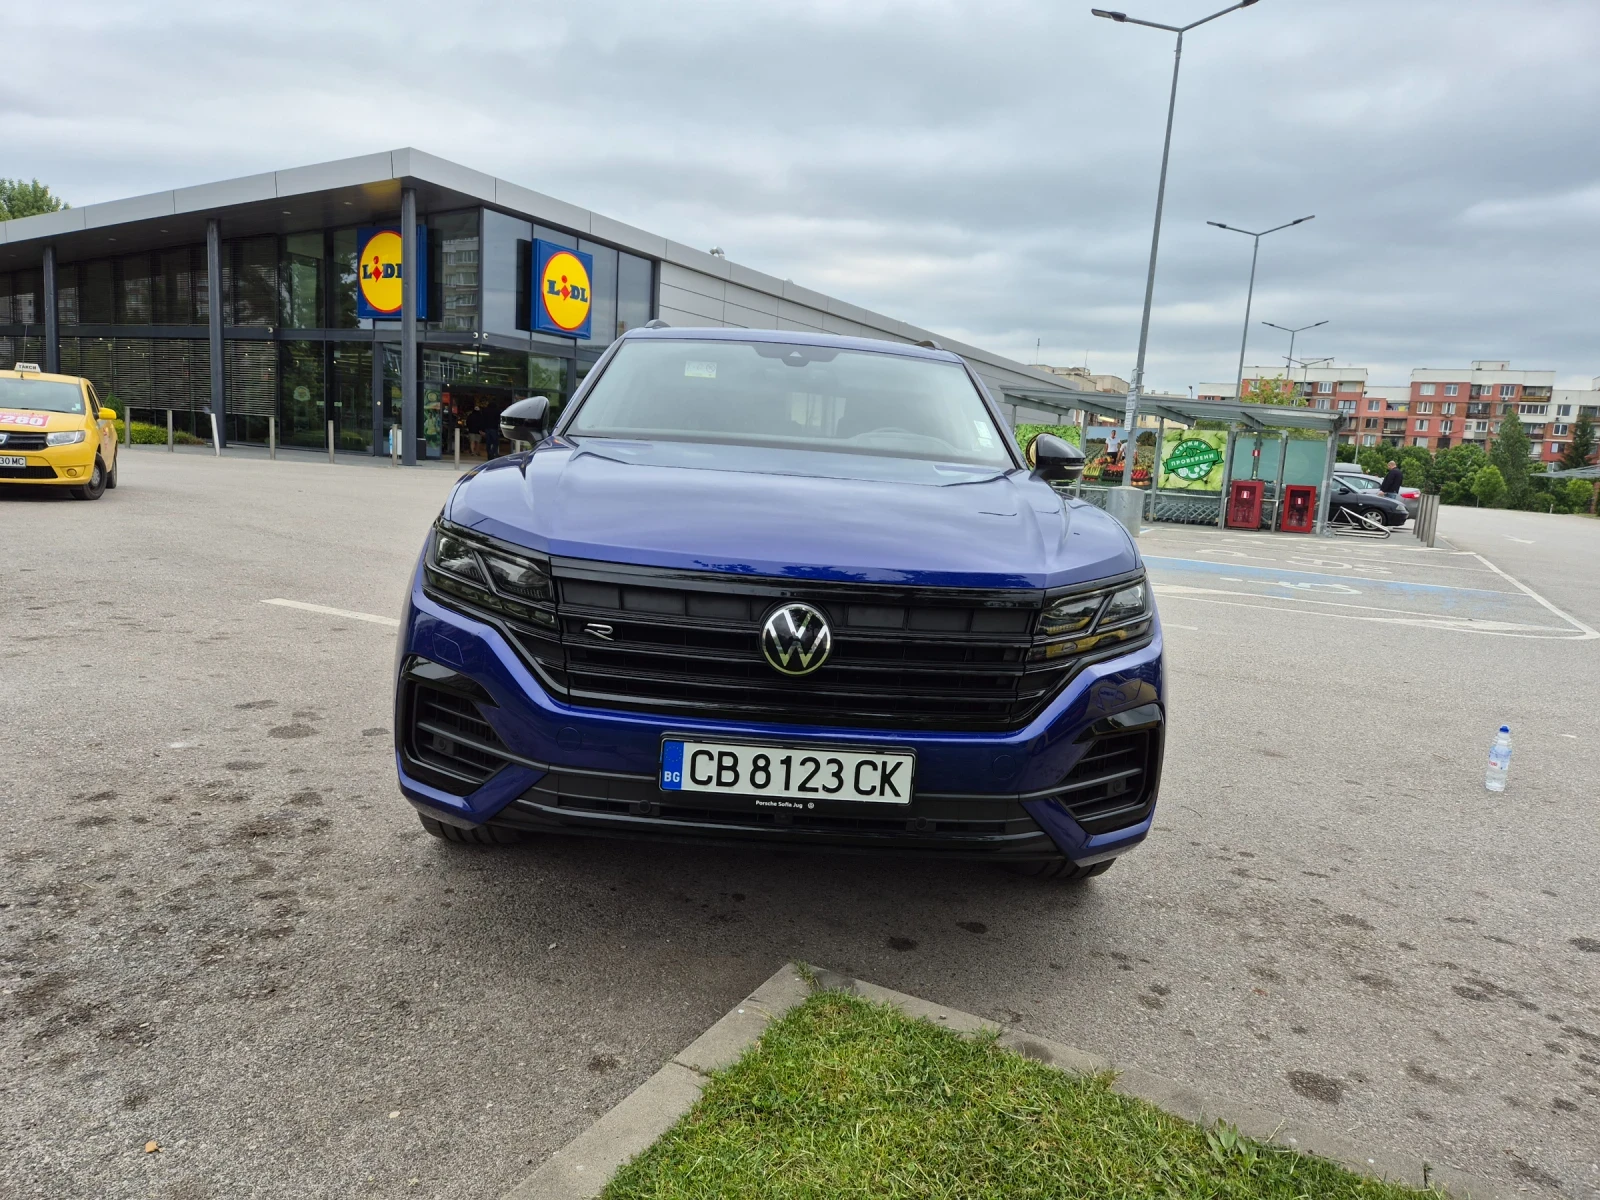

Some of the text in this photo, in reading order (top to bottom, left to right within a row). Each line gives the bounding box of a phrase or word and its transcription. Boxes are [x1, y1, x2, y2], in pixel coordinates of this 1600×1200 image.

[547, 275, 588, 303] LIDL
[1175, 441, 1199, 454] СВЕЖИ
[12, 457, 24, 466] MC
[1171, 453, 1214, 467] ПРОВЕРЕНИ
[664, 771, 680, 783] BG
[690, 749, 904, 797] CB 8123 CK
